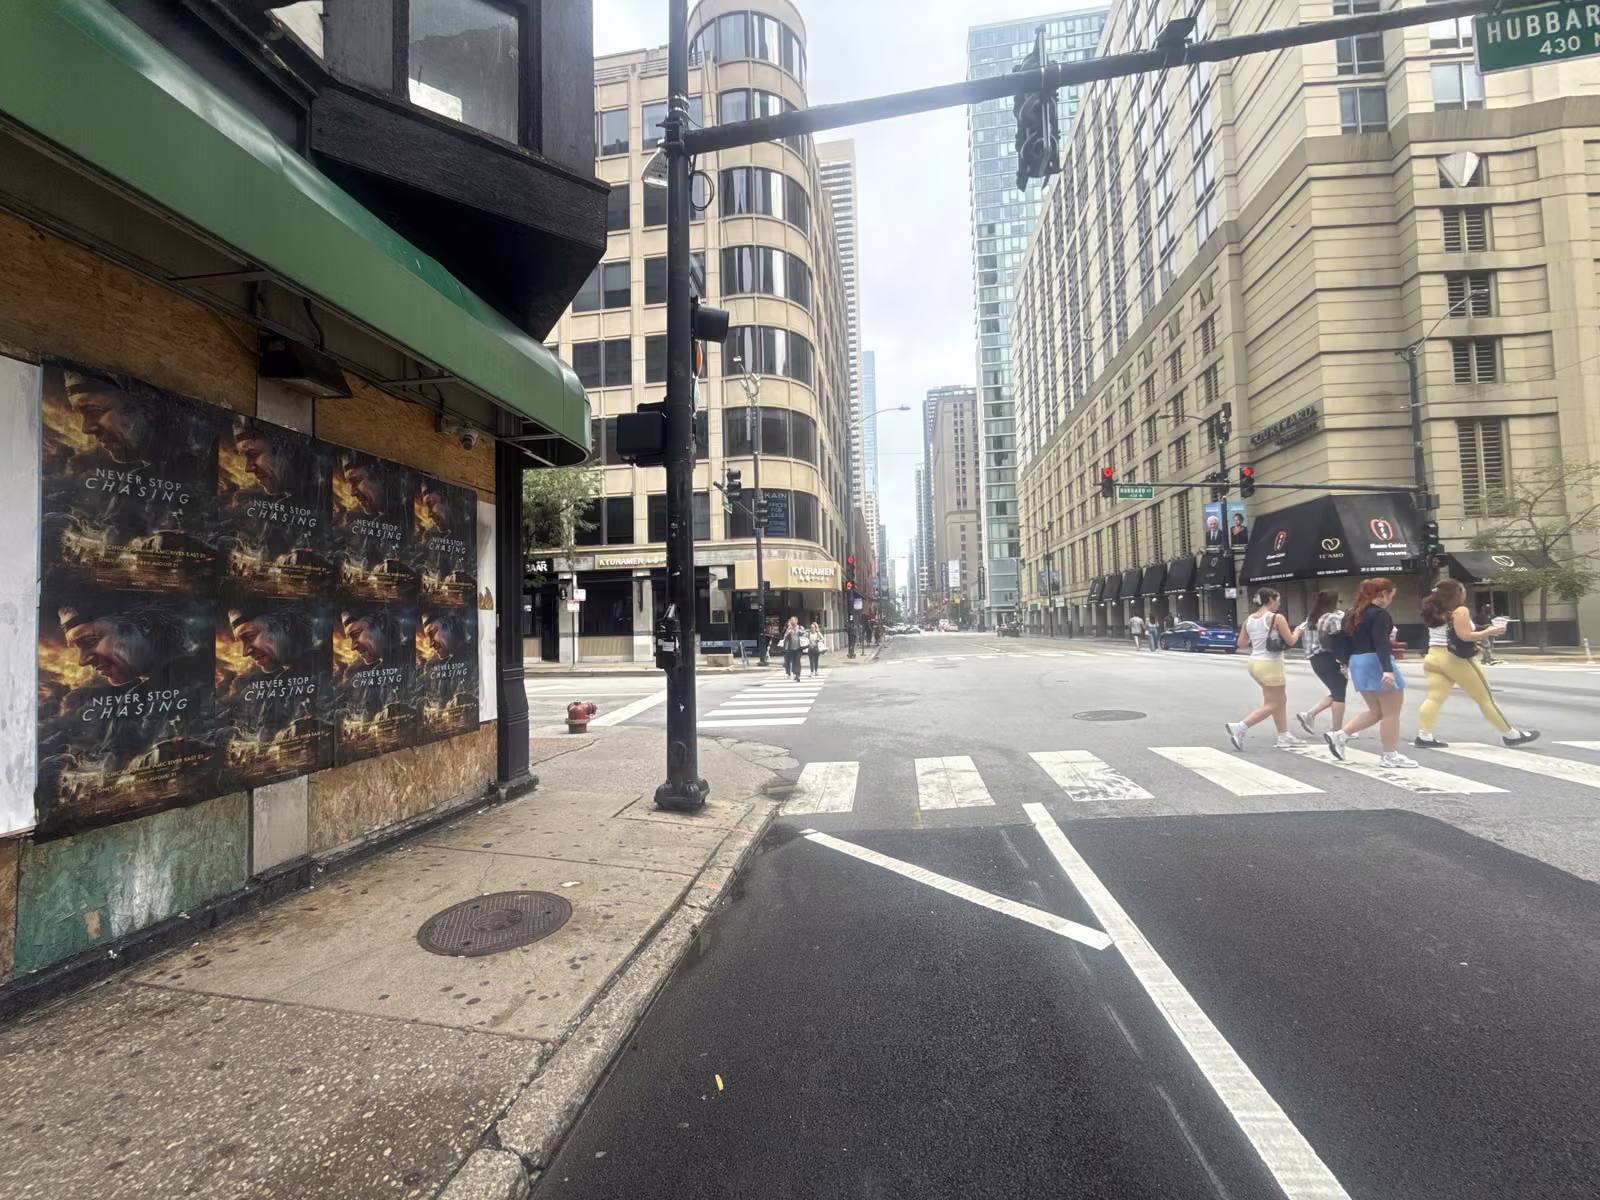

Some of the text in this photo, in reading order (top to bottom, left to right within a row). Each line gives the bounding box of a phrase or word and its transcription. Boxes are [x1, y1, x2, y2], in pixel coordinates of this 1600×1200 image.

[1487, 4, 1600, 44] HUBBAR
[1540, 35, 1580, 55] 430
[96, 468, 182, 491] NEVER STOP
[85, 478, 190, 504] CHASING
[254, 499, 311, 516] NEVER STOP
[247, 507, 317, 528] CHASING
[352, 525, 402, 540] CHASING
[356, 519, 398, 532] NEVER STOP
[429, 542, 466, 554] CHASING
[432, 537, 464, 547] NEVER STOP
[600, 558, 644, 566] KYURAMEN
[791, 567, 835, 576] KYURAMEN
[356, 668, 398, 678] NEVER STOP
[430, 668, 468, 680] CHASING
[433, 662, 465, 672] NEVER STOP
[252, 677, 309, 690] NEVER STOP
[352, 674, 402, 688] CHASING
[93, 689, 180, 707] NEVER STOP
[244, 684, 315, 701] CHASING
[82, 698, 188, 721] CHASING
